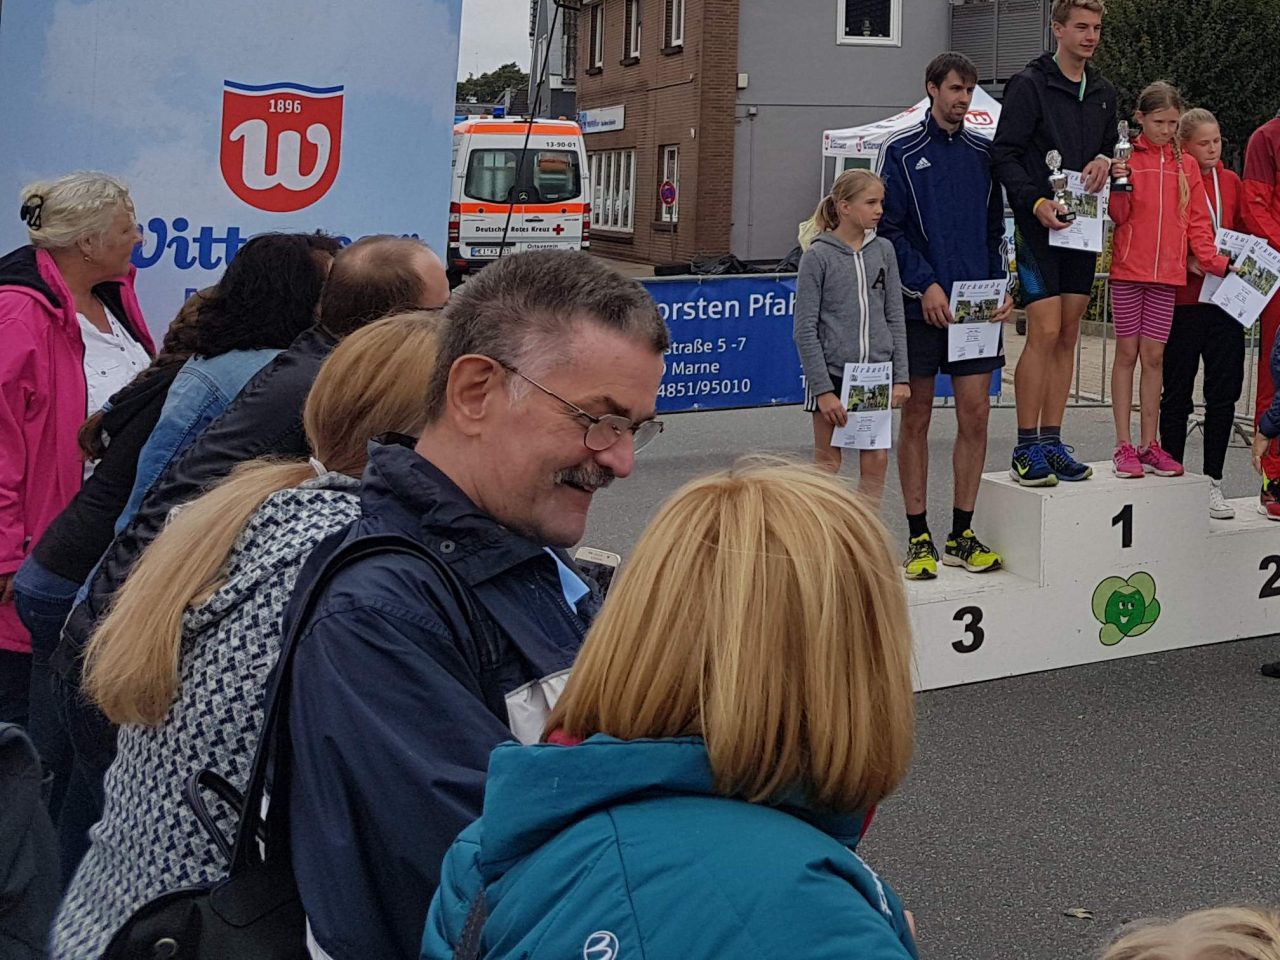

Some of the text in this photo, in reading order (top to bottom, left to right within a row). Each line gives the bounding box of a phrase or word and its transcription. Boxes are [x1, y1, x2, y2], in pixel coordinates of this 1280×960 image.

[269, 99, 301, 114] 1896
[871, 267, 886, 291] A
[656, 296, 740, 321] orsten
[663, 338, 713, 356] straße
[717, 337, 727, 353] 5
[671, 360, 721, 377] Marne
[656, 377, 751, 399] 4851/95010
[1111, 503, 1134, 549] 1
[950, 604, 986, 655] 3
